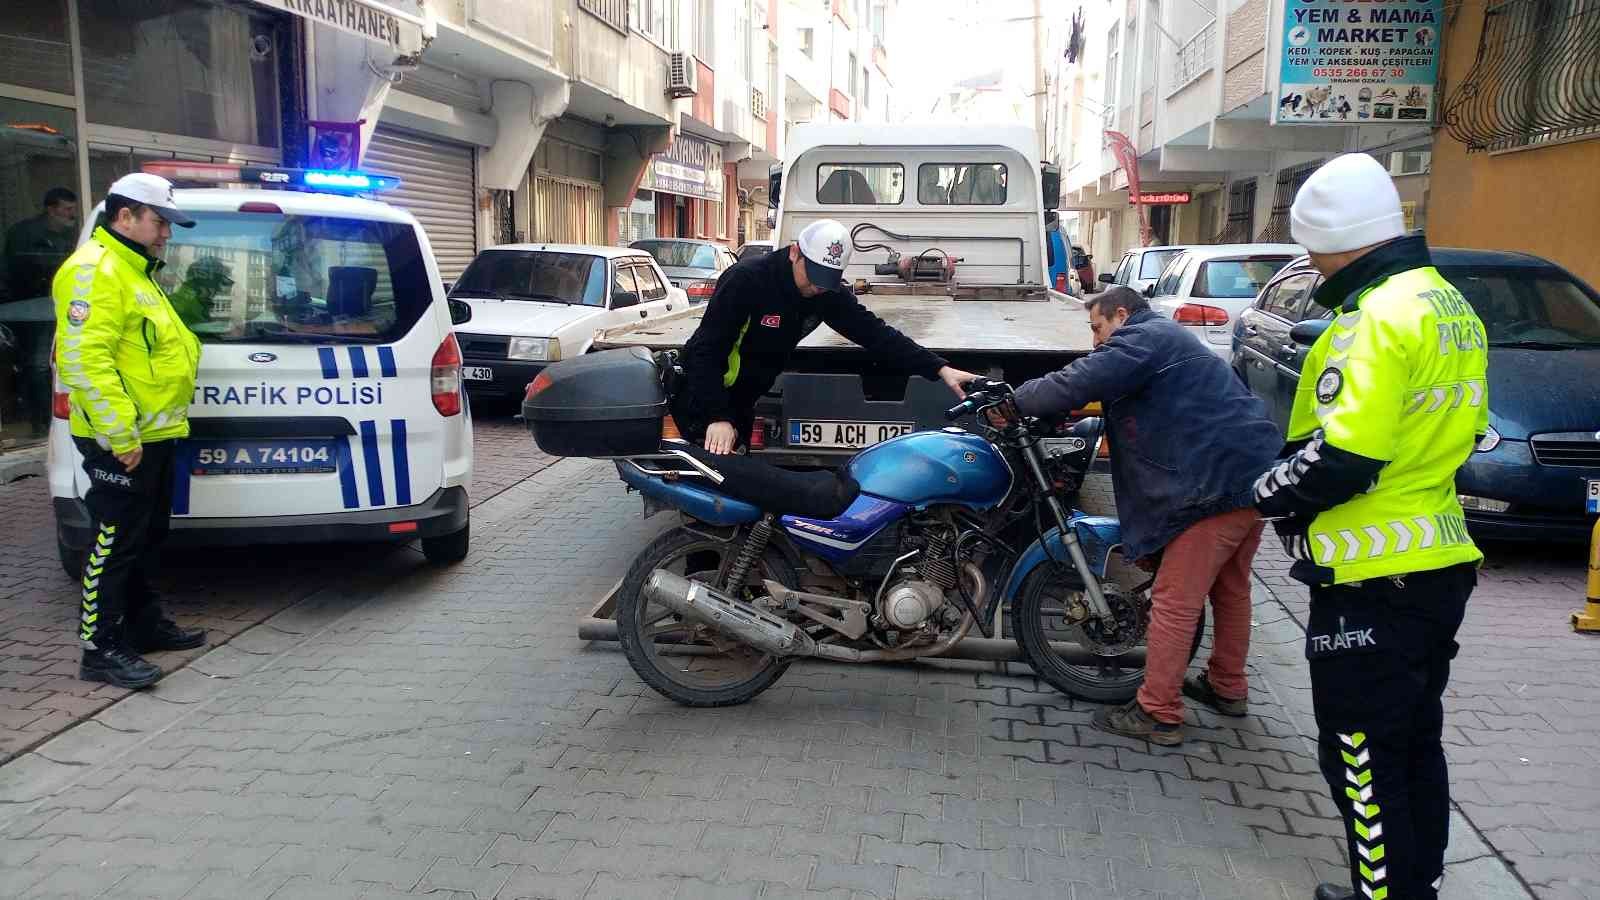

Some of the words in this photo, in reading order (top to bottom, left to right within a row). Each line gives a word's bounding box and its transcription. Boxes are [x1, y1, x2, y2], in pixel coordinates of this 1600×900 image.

[1294, 9, 1339, 23] YEM
[1347, 9, 1361, 23] &
[1370, 9, 1435, 23] MAMA
[1317, 28, 1409, 43] MARKET
[1288, 58, 1309, 66] YEM
[1312, 58, 1325, 66] VE
[1328, 58, 1379, 66] AKSESUAR
[1313, 68, 1343, 78] 0535
[1346, 68, 1368, 78] 266
[1372, 68, 1387, 78] 67
[1391, 68, 1405, 78] 30
[472, 367, 490, 379] 430
[190, 382, 287, 405] TRAFİK
[297, 382, 382, 405] POLİSİ
[801, 424, 822, 443] 59
[834, 424, 866, 445] ACH
[200, 448, 227, 465] 59
[233, 448, 252, 464] A
[258, 447, 329, 463] 74104
